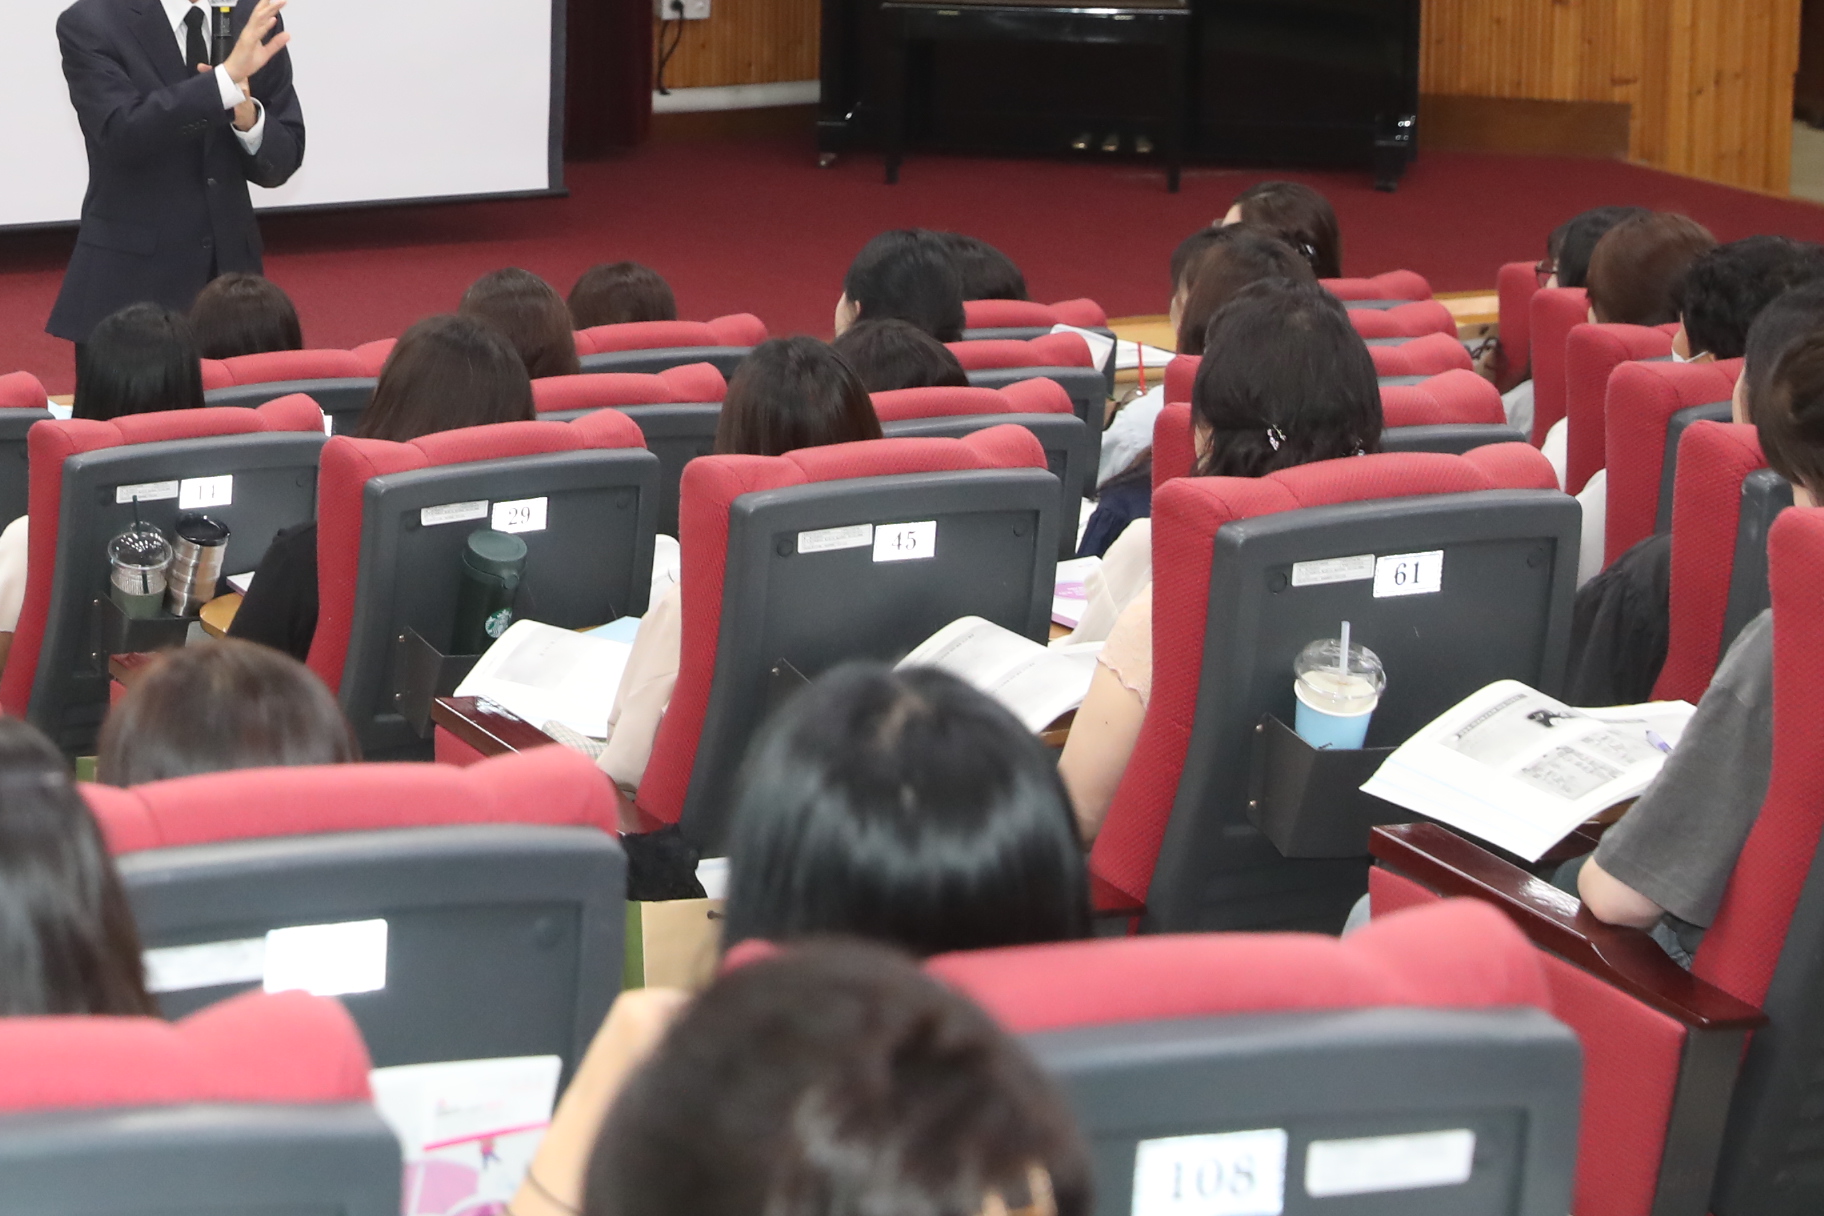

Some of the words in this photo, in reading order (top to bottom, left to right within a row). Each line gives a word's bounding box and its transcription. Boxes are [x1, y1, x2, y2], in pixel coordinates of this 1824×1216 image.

[508, 507, 531, 526] 29
[892, 531, 917, 551] 45
[1394, 561, 1420, 586] 61
[1172, 1156, 1257, 1200] 108
